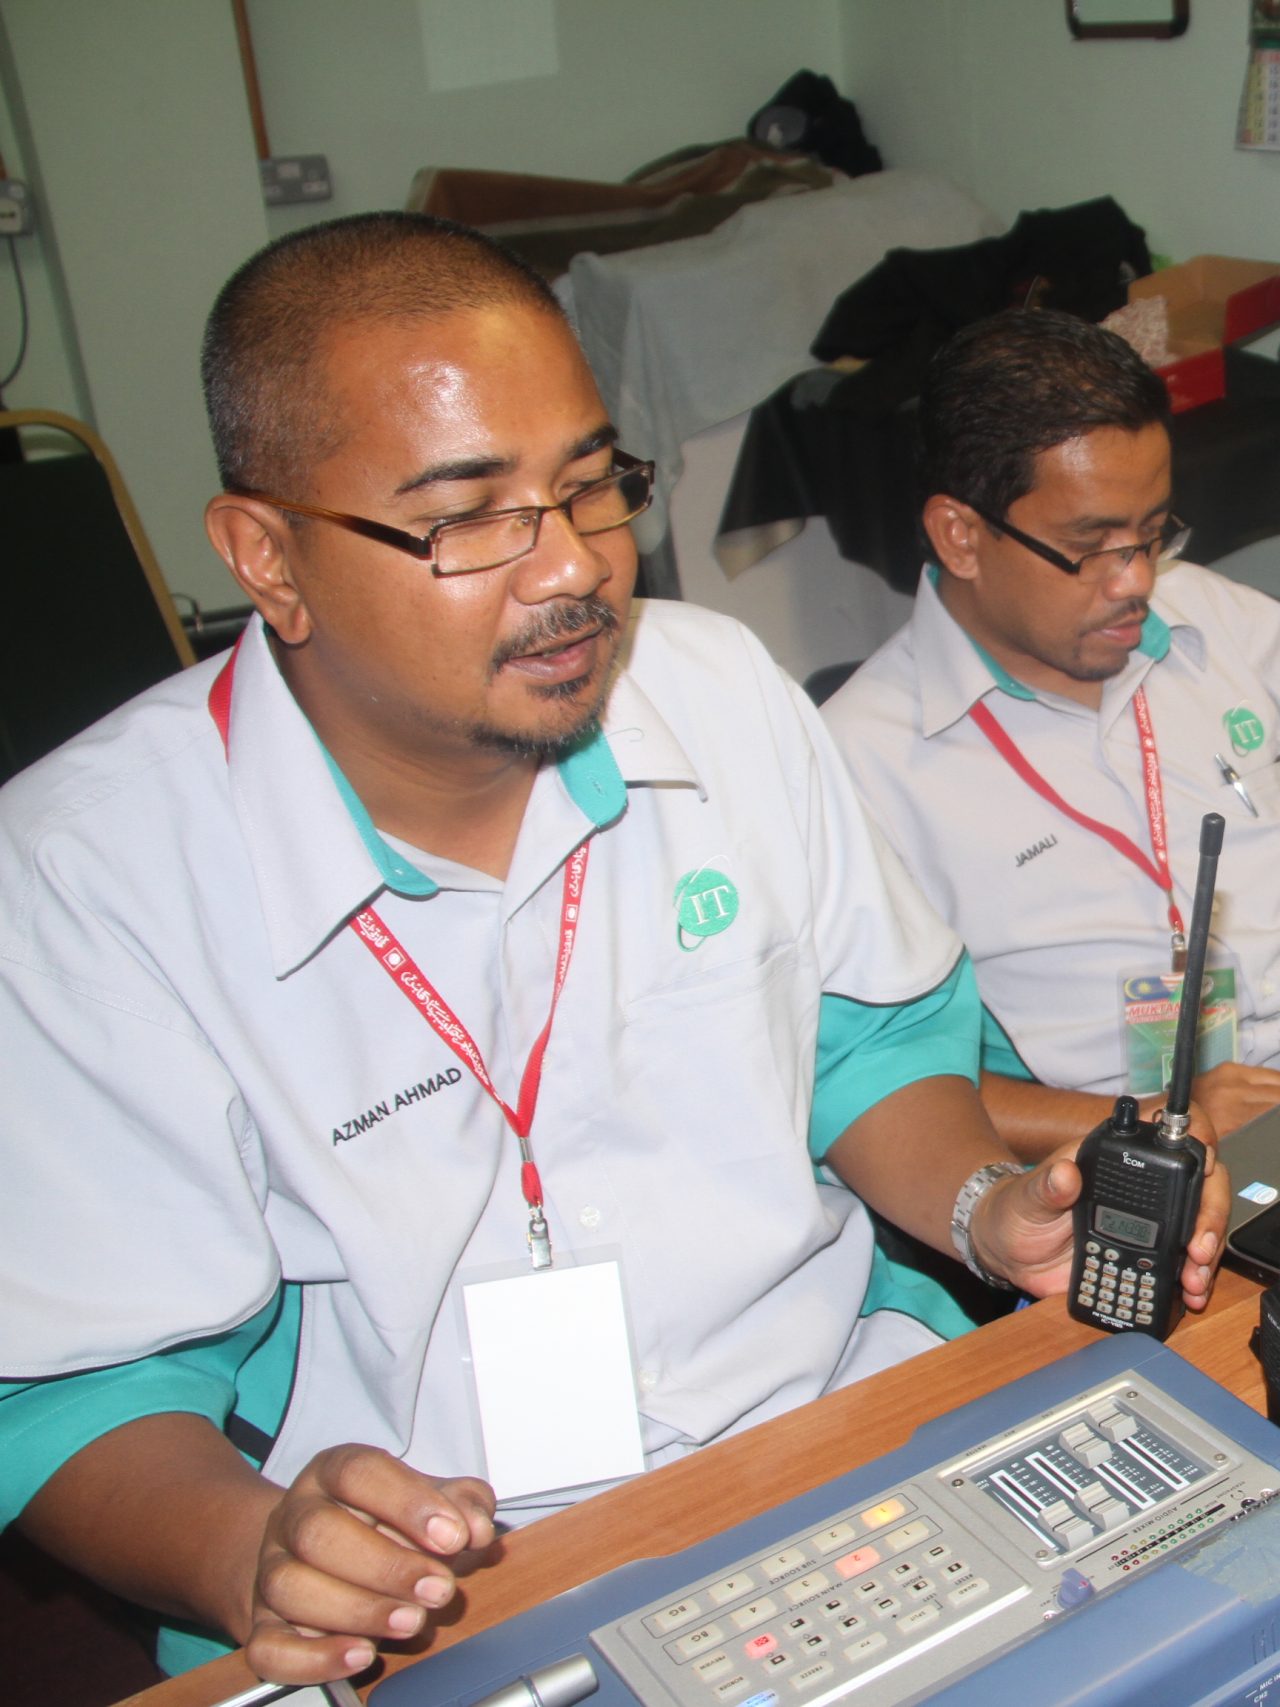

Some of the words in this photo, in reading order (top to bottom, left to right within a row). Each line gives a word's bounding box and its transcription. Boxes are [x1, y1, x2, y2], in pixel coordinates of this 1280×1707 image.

[1232, 719, 1260, 743] IT
[1015, 833, 1058, 867] JAMALI
[687, 885, 730, 926] IT
[1129, 1002, 1180, 1018] MUKTA
[332, 1100, 391, 1147] AZMAN
[394, 1067, 462, 1112] AHMAD
[1155, 1506, 1178, 1522] AUDIO
[1133, 1520, 1155, 1534] MIXER
[769, 1566, 801, 1586] SOURCE
[902, 1575, 923, 1588] RIGHT
[954, 1573, 974, 1586] RESET
[820, 1581, 844, 1596] MAIN
[788, 1593, 820, 1612] SOURCE
[668, 1605, 687, 1618] BG
[691, 1630, 709, 1643] BG
[699, 1654, 727, 1671] PREVIEW
[800, 1665, 823, 1680] FREEZE
[719, 1676, 744, 1692] BORDER
[1259, 1679, 1274, 1691] MIC
[1254, 1691, 1269, 1703] CH2
